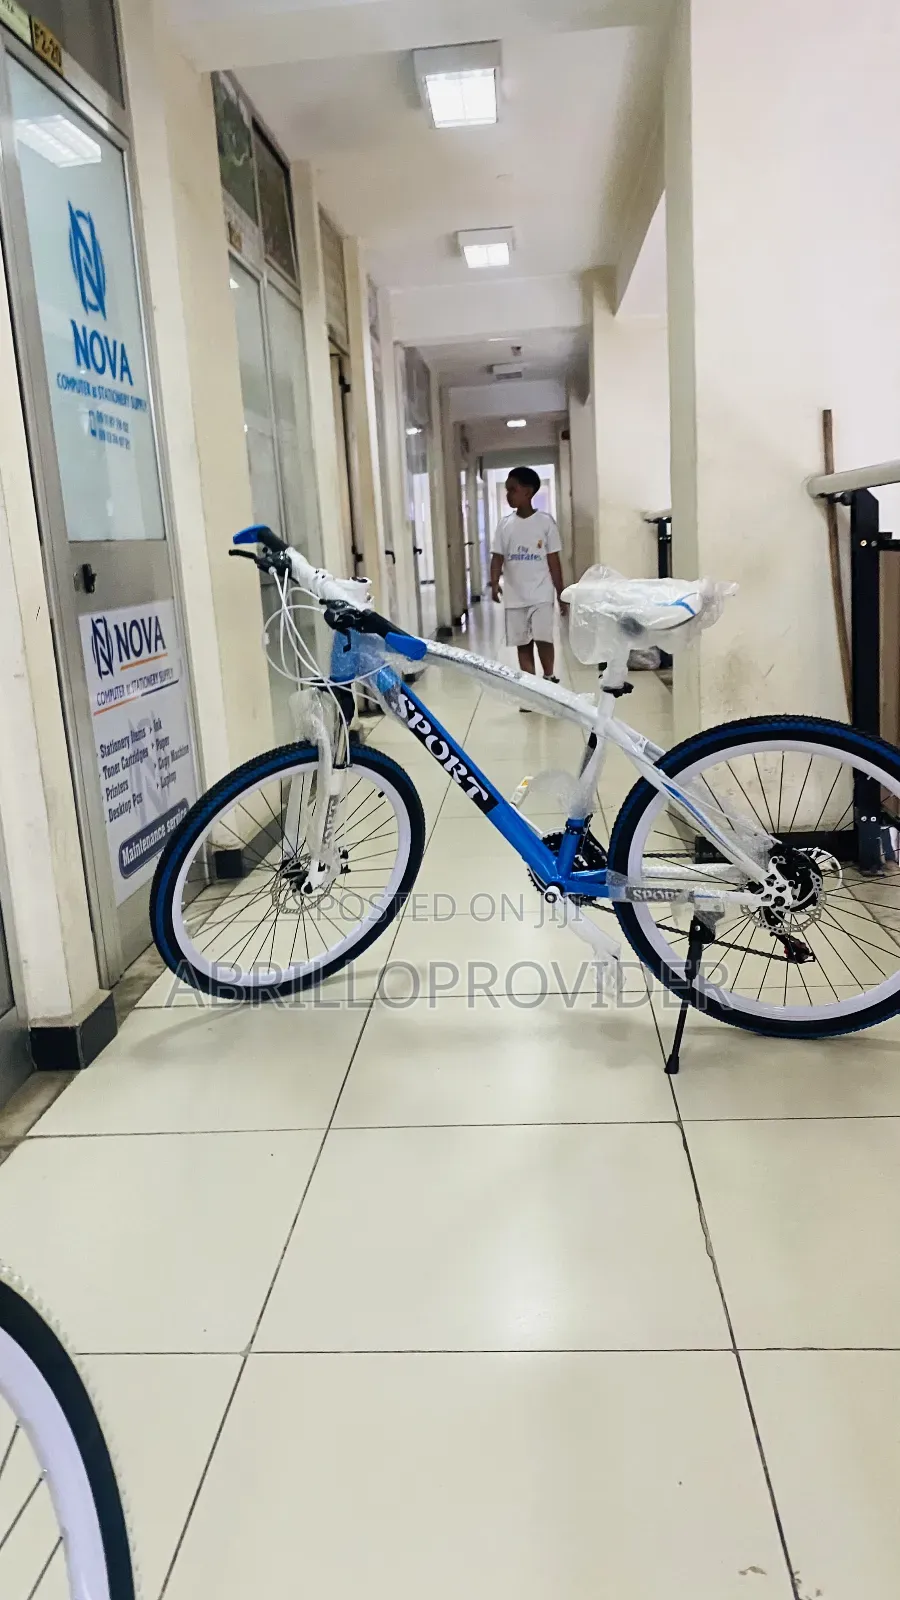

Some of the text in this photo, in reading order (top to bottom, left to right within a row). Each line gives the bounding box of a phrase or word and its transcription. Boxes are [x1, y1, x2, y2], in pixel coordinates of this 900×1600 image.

[70, 319, 134, 386] NOVA
[113, 615, 167, 663] NOVA
[96, 684, 125, 706] COMPUTER
[99, 727, 147, 759] Stationery Items
[155, 735, 170, 752] Paper
[398, 693, 489, 801] SPORT
[102, 747, 149, 780] Toner Cartridges
[105, 779, 129, 803] Printers
[108, 799, 132, 823] Desktop
[121, 824, 166, 868] Maintenance
